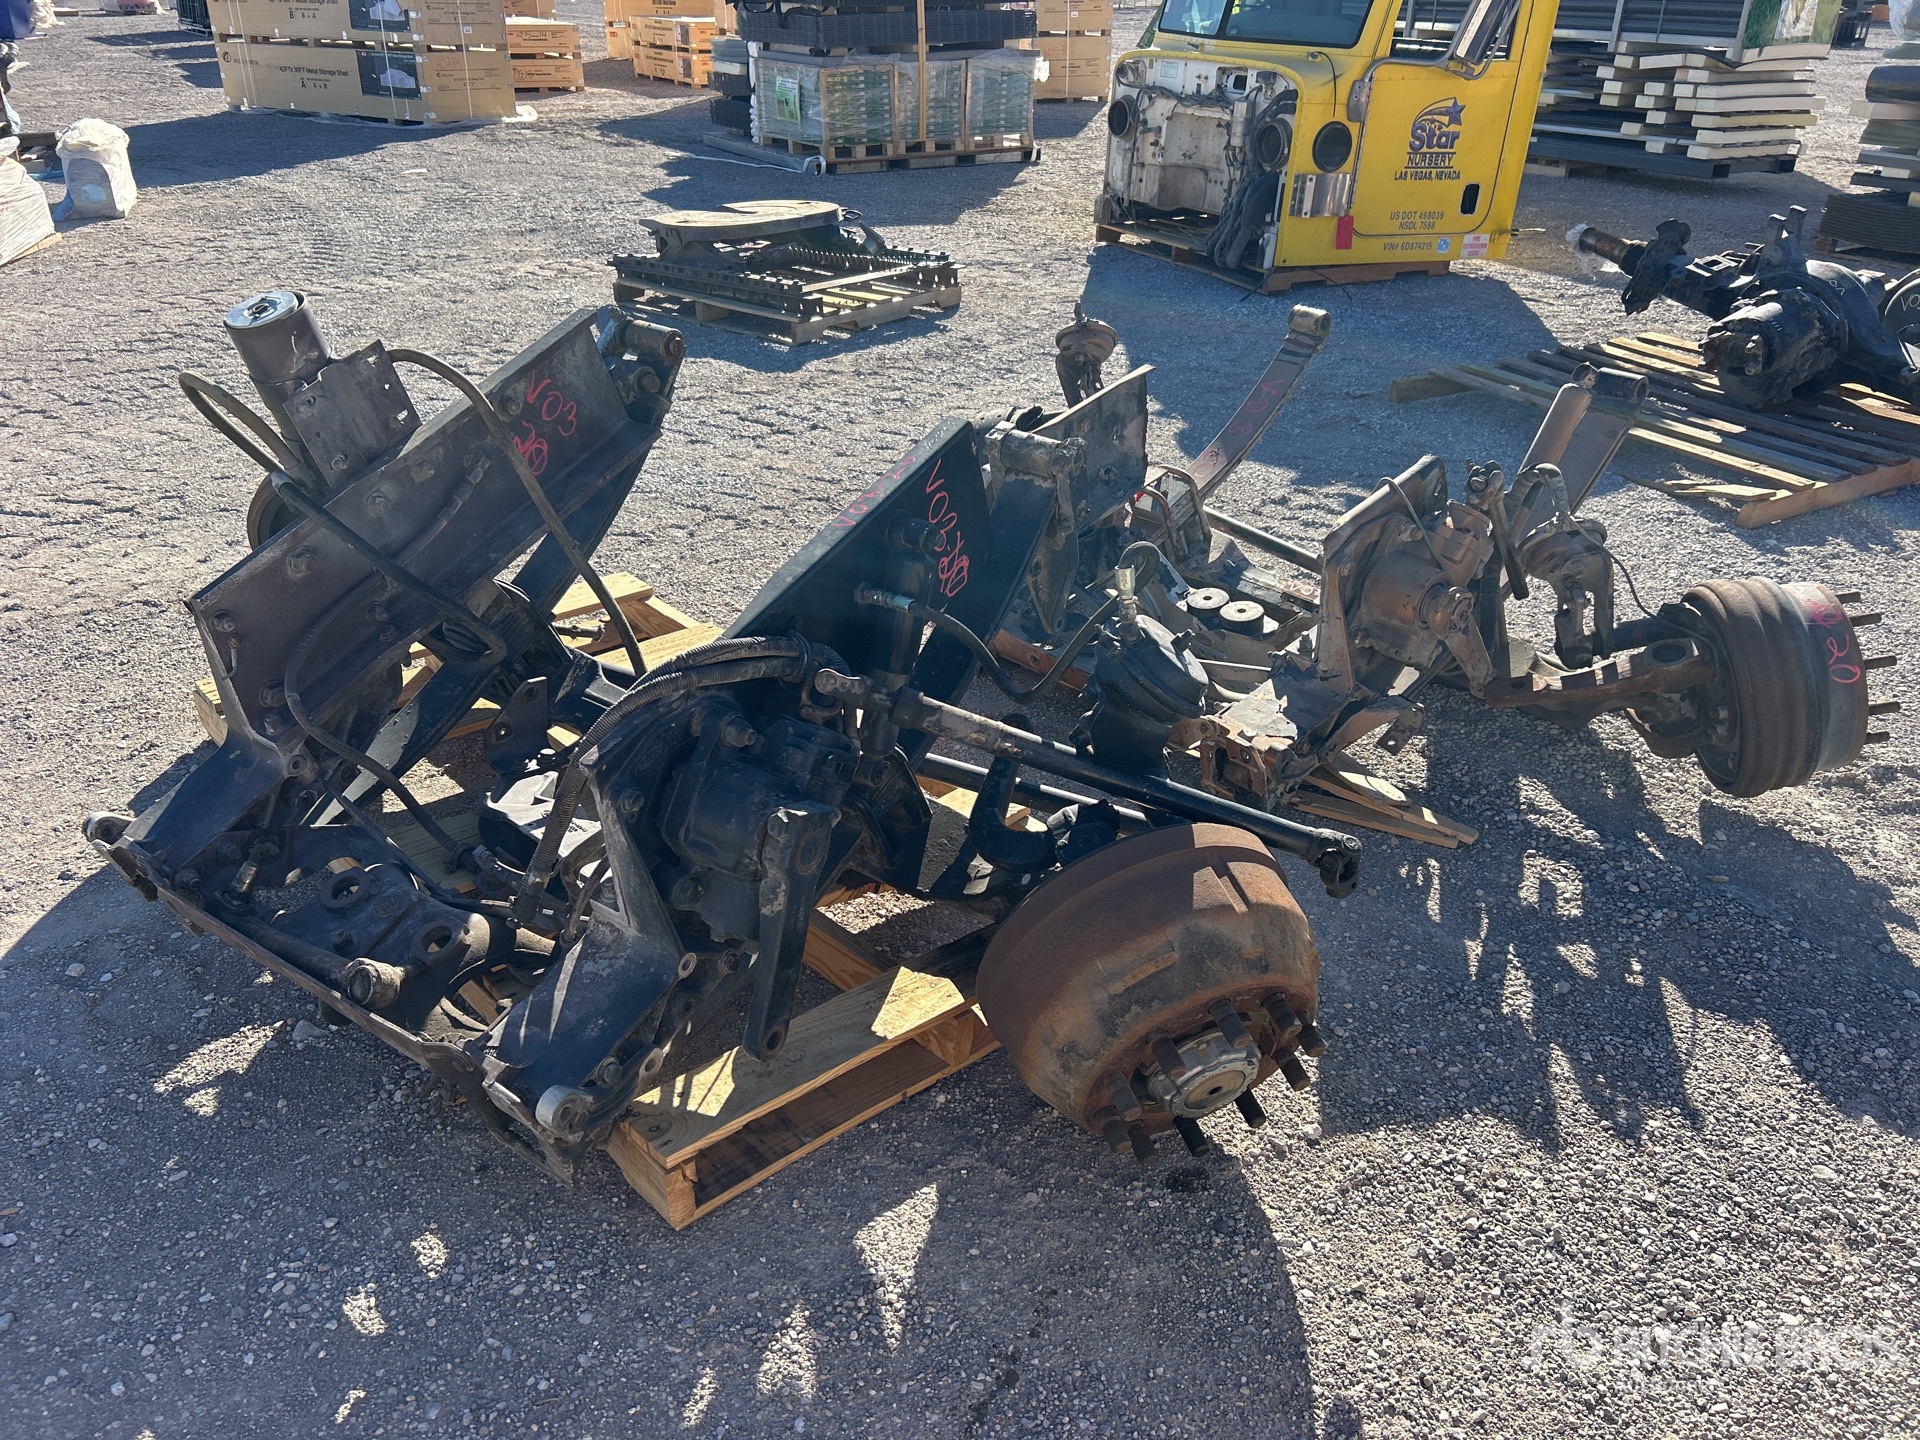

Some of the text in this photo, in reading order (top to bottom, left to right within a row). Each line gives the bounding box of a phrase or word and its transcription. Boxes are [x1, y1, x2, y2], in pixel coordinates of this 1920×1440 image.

[1409, 121, 1460, 152] Star
[1407, 153, 1455, 166] NURSERY
[1394, 170, 1461, 182] LAS VEGAS, NEVADA
[1390, 211, 1444, 220] US DOT 498039
[1399, 221, 1417, 230] NSDL
[1383, 242, 1399, 251] VIN#
